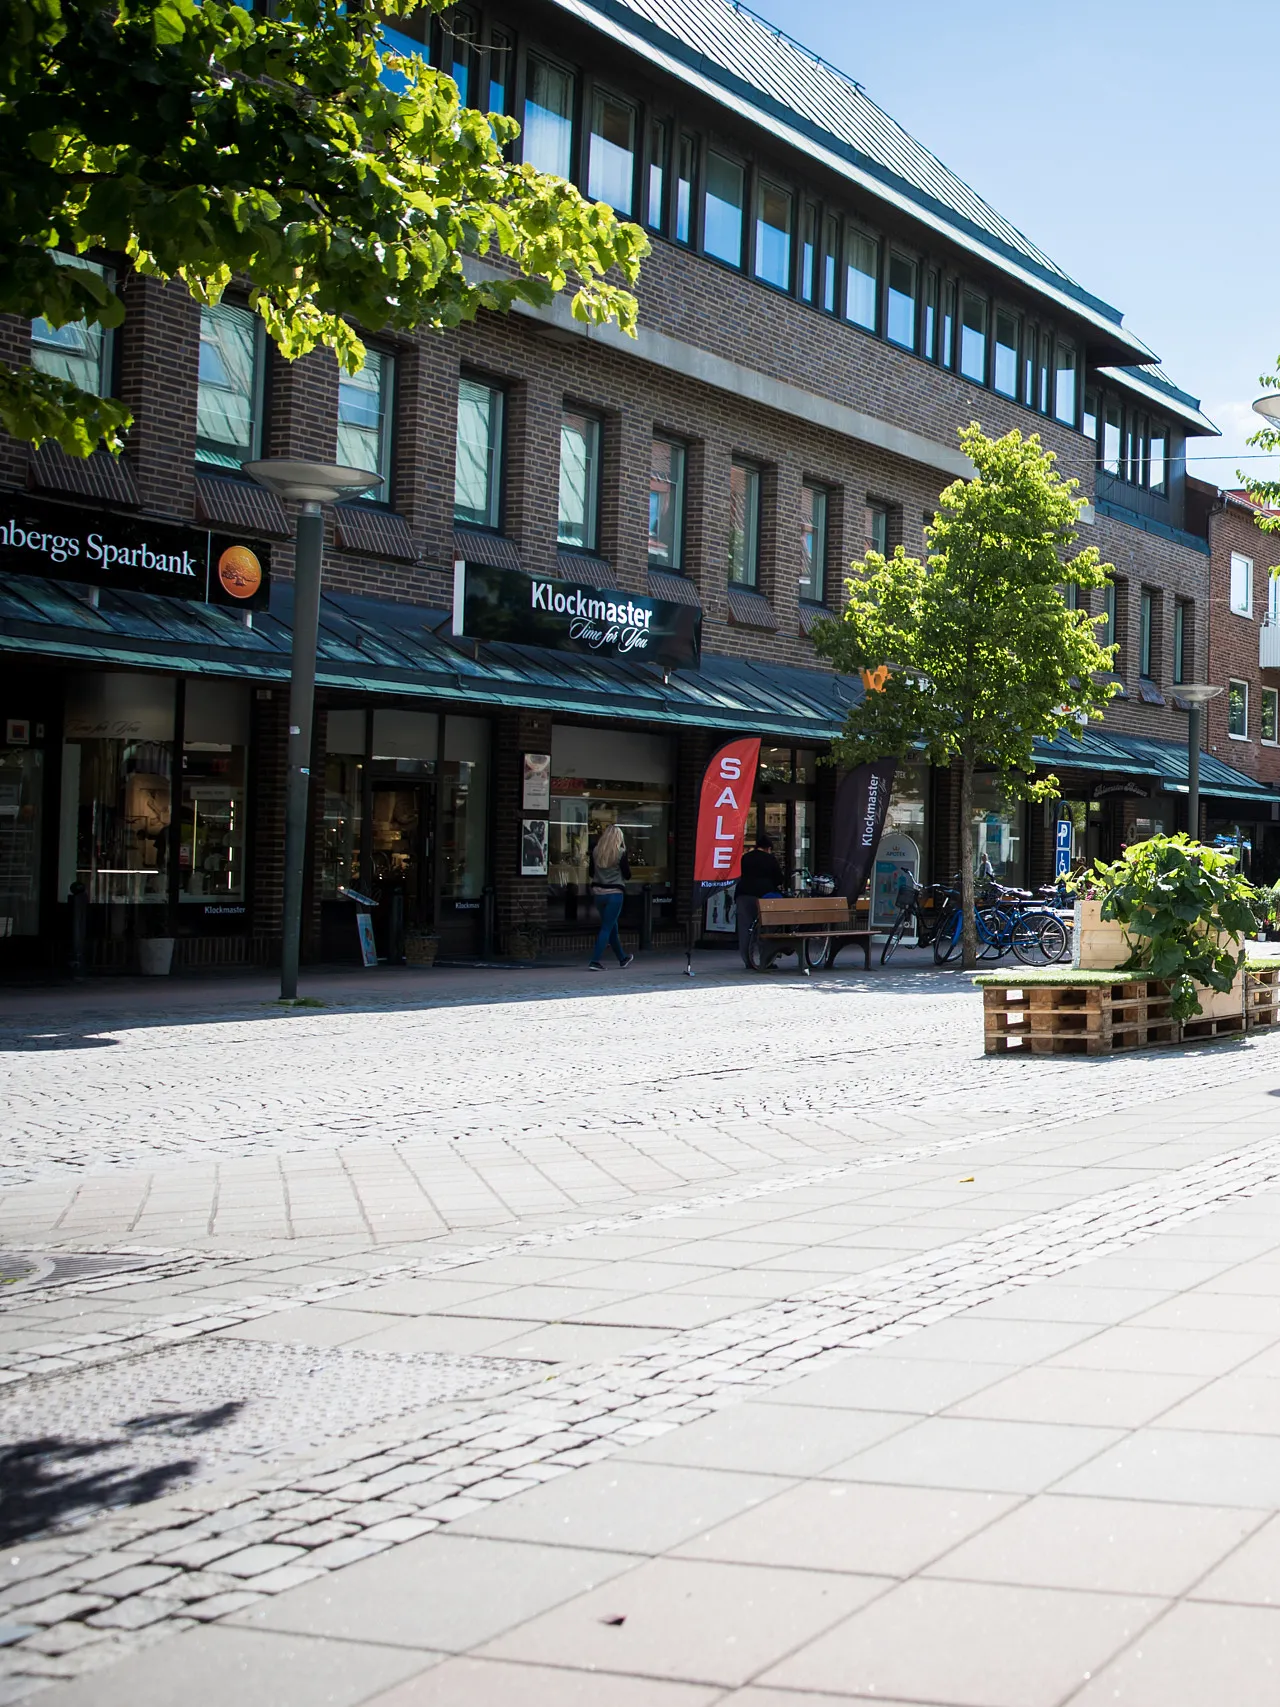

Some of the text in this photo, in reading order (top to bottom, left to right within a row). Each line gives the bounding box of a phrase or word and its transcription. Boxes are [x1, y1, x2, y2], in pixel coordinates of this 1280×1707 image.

[86, 533, 197, 577] Sparbank
[531, 581, 653, 629] Klockmaster
[569, 616, 651, 653] Time for You
[713, 757, 742, 869] SALE
[862, 773, 879, 847] Klockmaster
[1058, 823, 1068, 846] P
[204, 904, 246, 915] Klockmaster
[455, 901, 480, 910] Klockmas
